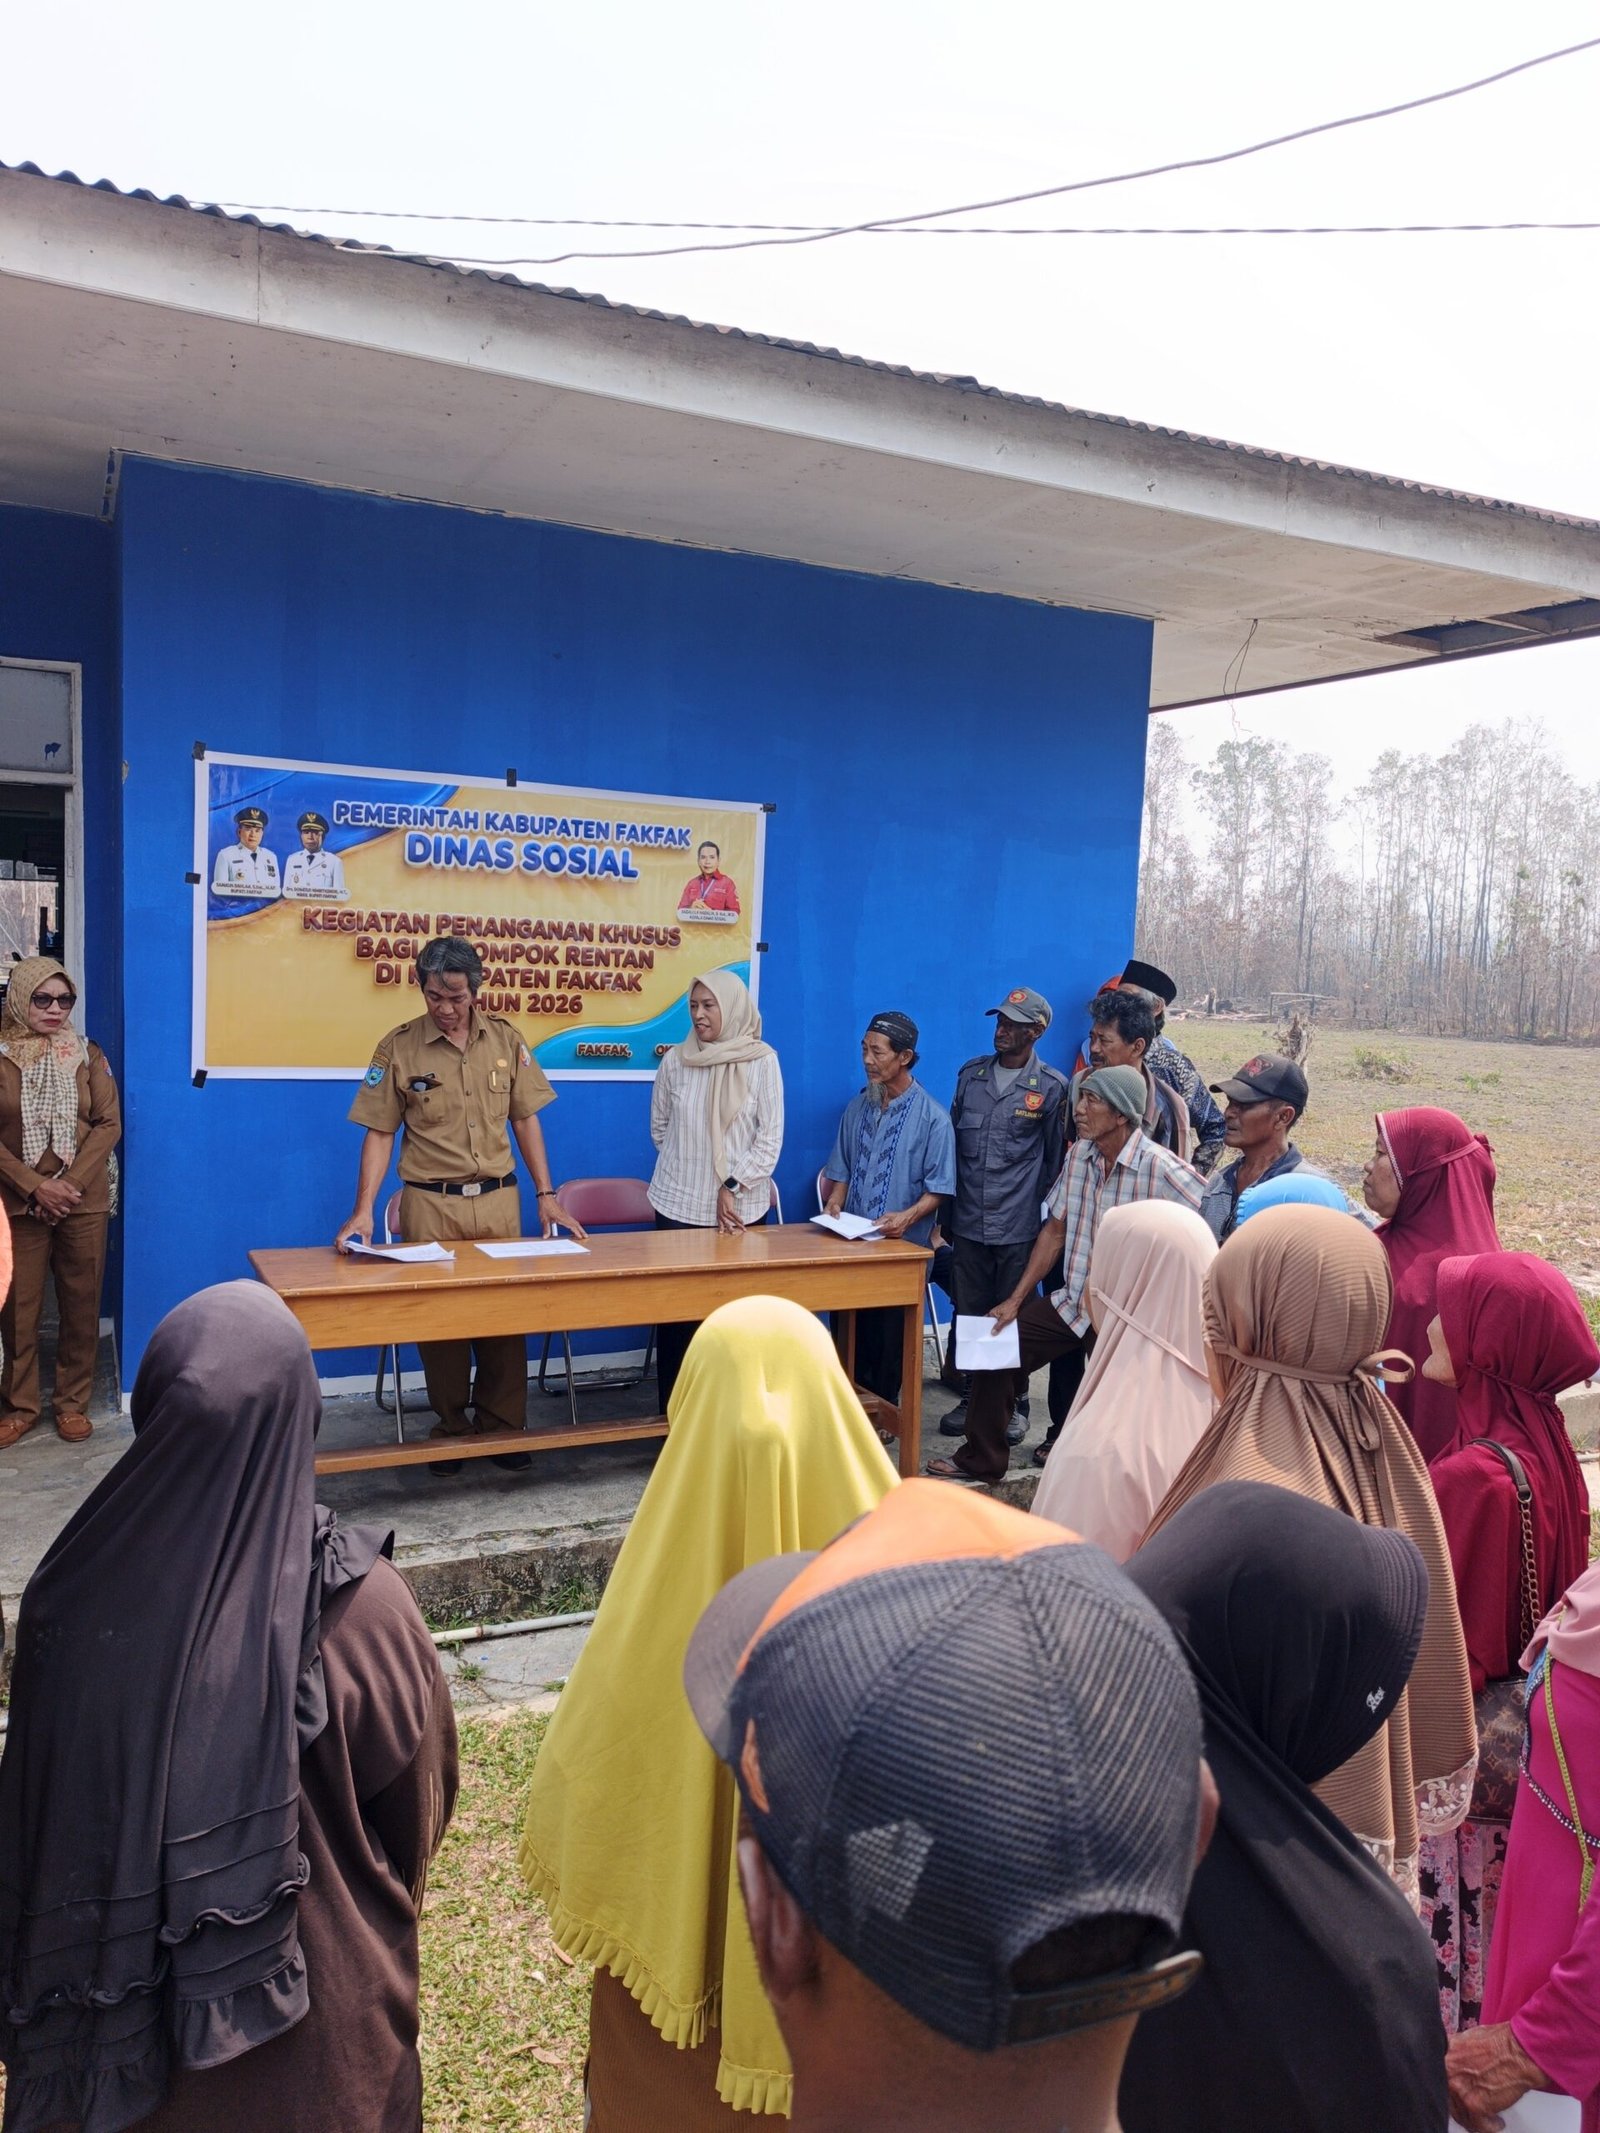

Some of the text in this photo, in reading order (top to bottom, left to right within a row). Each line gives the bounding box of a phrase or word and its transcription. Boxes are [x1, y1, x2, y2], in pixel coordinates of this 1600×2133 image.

[335, 802, 691, 847] PEMERINTAH KABUPATEN FAKFAK
[407, 833, 639, 878] DINAS SOSIAL
[303, 907, 681, 947] KEGIATAN PENANGANAN KHUSUS
[356, 936, 655, 969] BAGI OMPOK RENTAN
[376, 962, 402, 985] DI
[556, 970, 643, 992] FAKFAK
[472, 991, 583, 1014] HUN 2026
[577, 1044, 632, 1057] FAKFAK,
